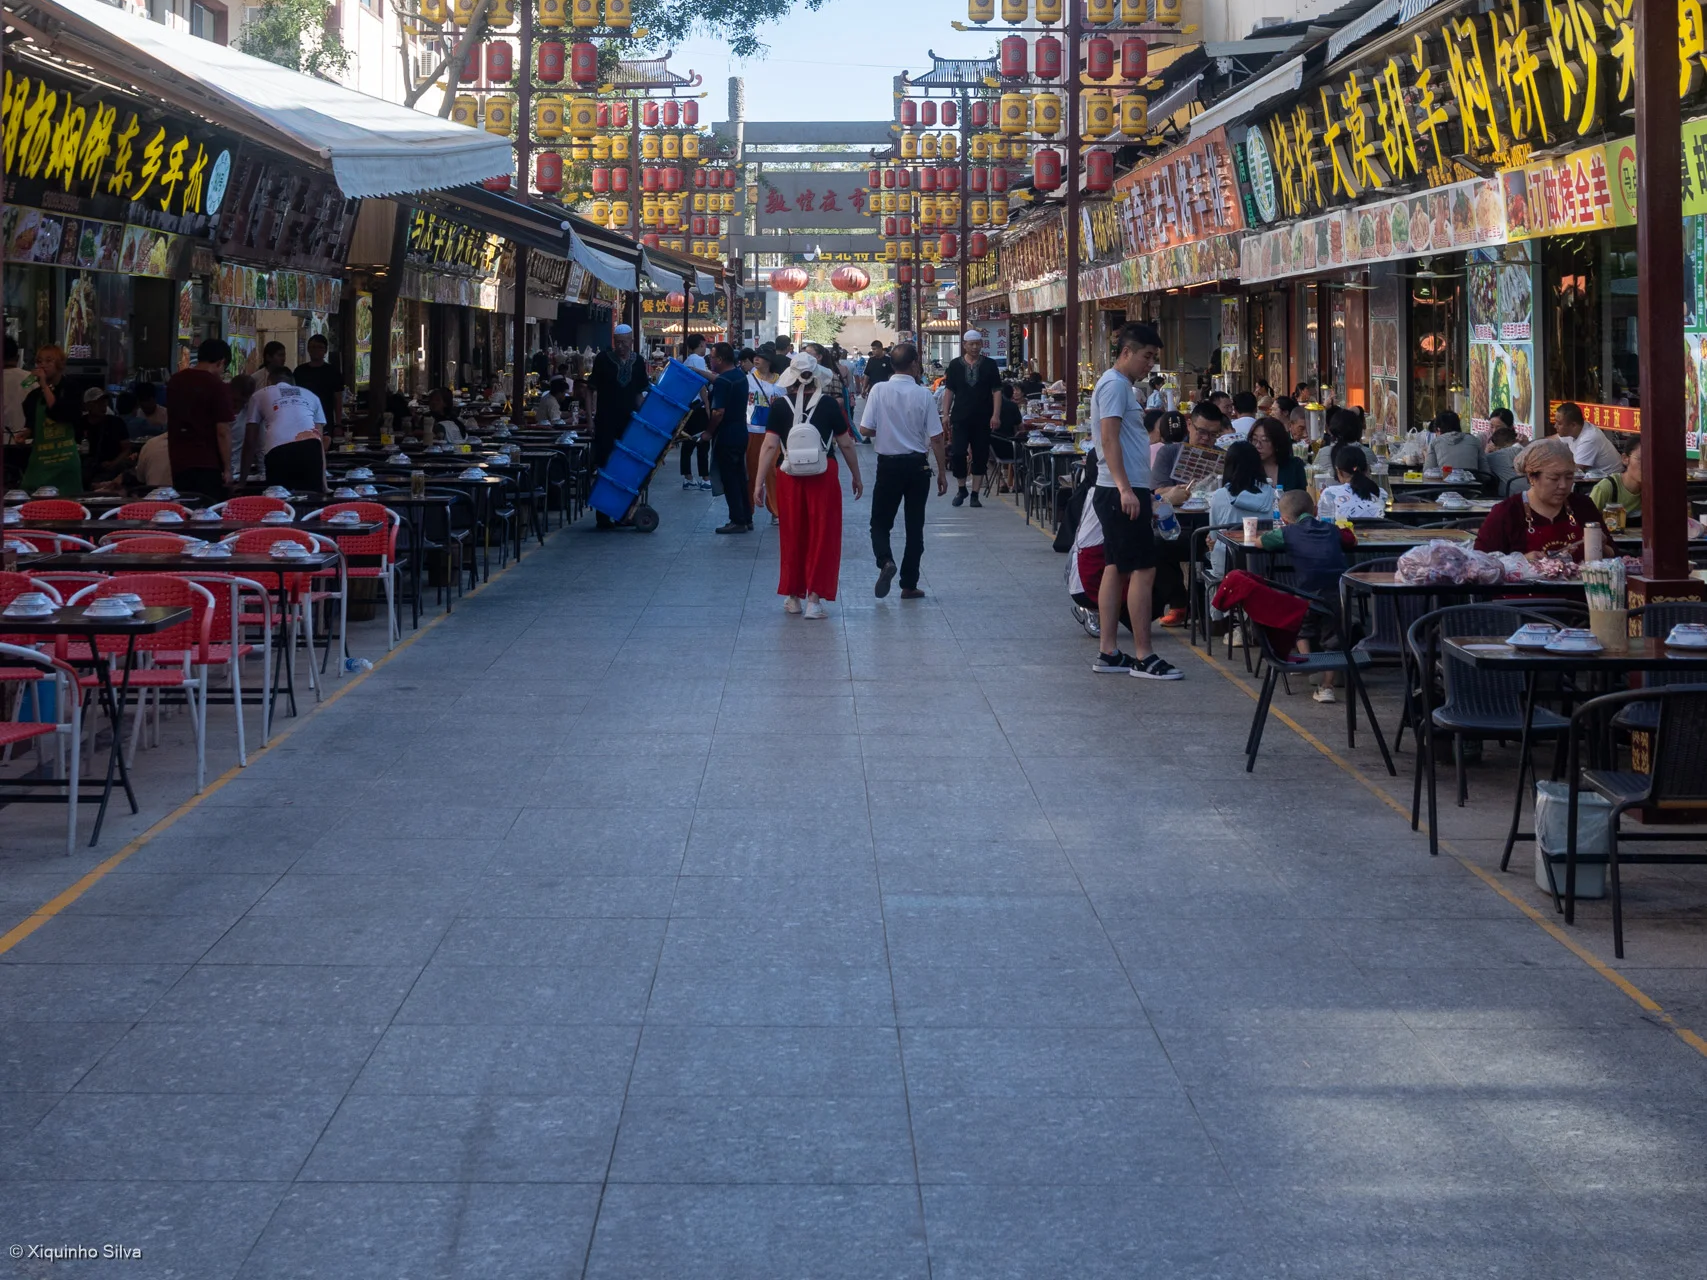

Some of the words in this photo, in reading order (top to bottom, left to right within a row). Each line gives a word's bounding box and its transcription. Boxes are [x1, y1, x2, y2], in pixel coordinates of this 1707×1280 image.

[765, 187, 867, 215] 敦煌夜市
[1528, 154, 1613, 230] 订做烤全羊
[1583, 406, 1621, 428] 空调开放
